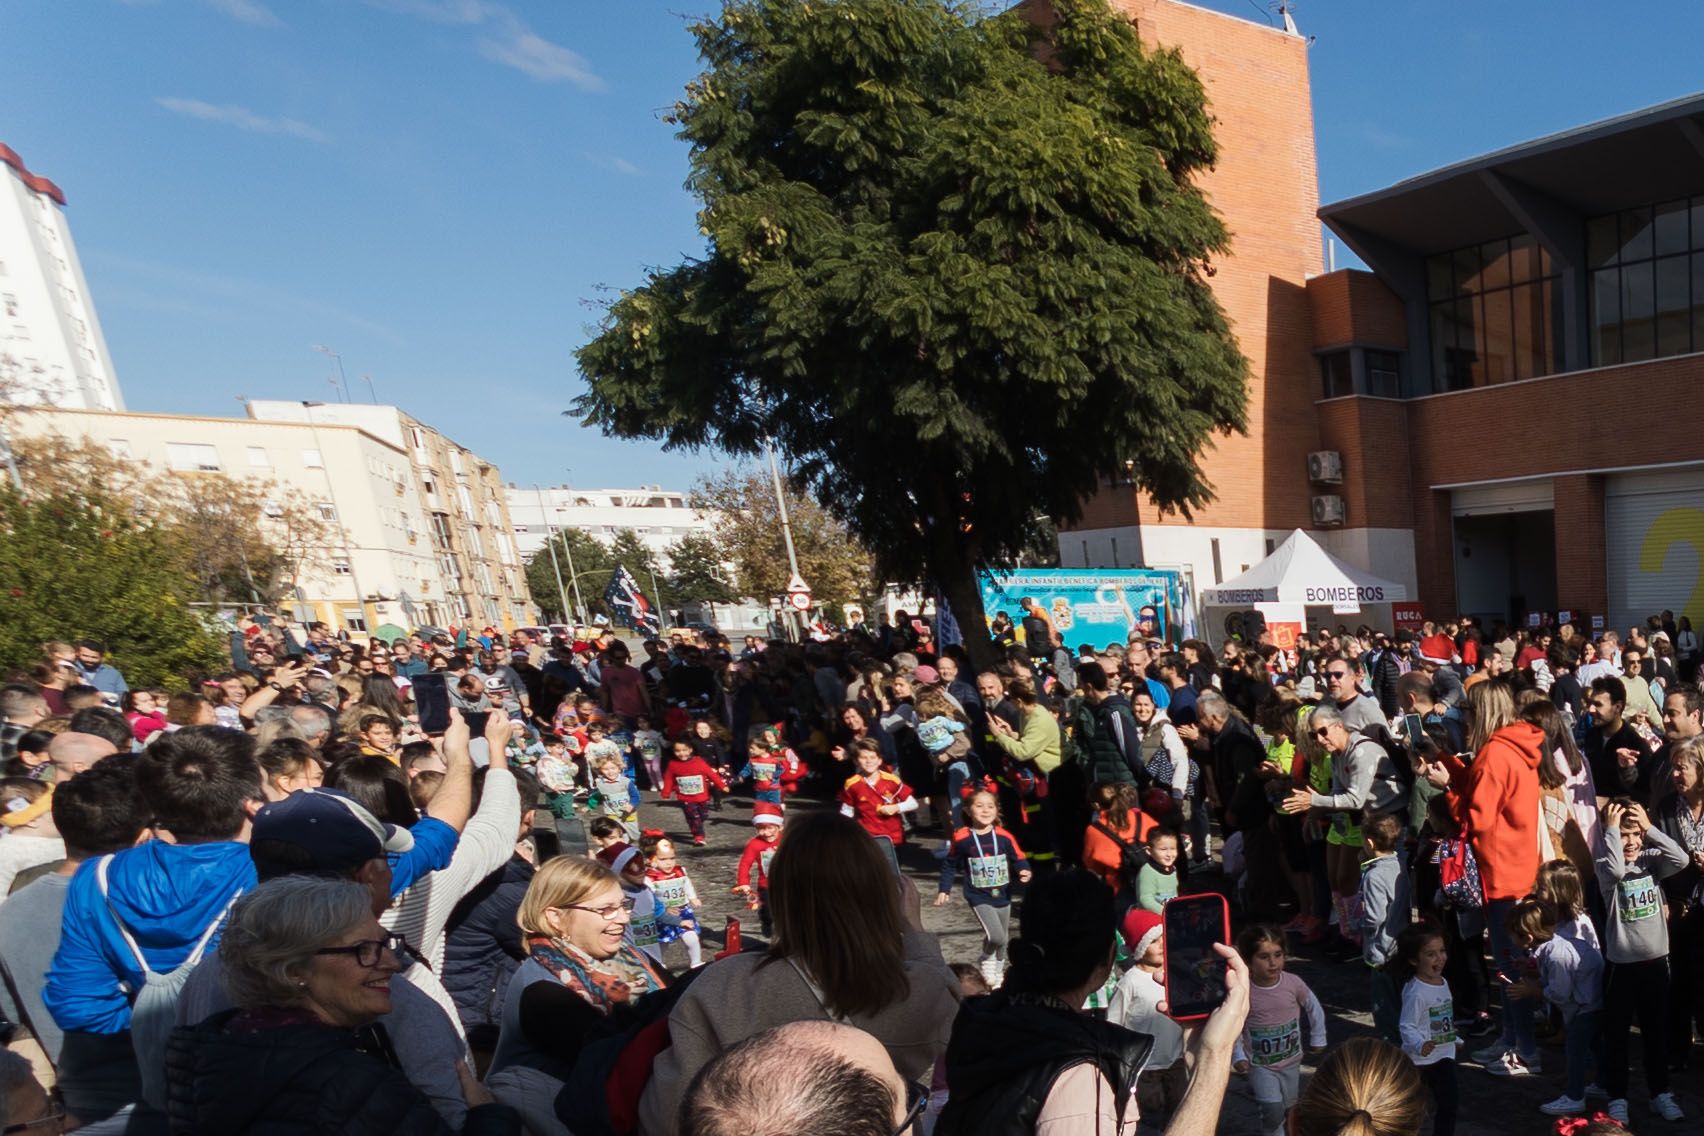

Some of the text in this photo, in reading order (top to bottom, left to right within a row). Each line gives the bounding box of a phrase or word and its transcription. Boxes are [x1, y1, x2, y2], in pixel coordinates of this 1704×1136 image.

[1217, 586, 1384, 603] BOMBEROS BOMBEROS
[663, 887, 685, 900] 432
[1628, 889, 1655, 908] 140
